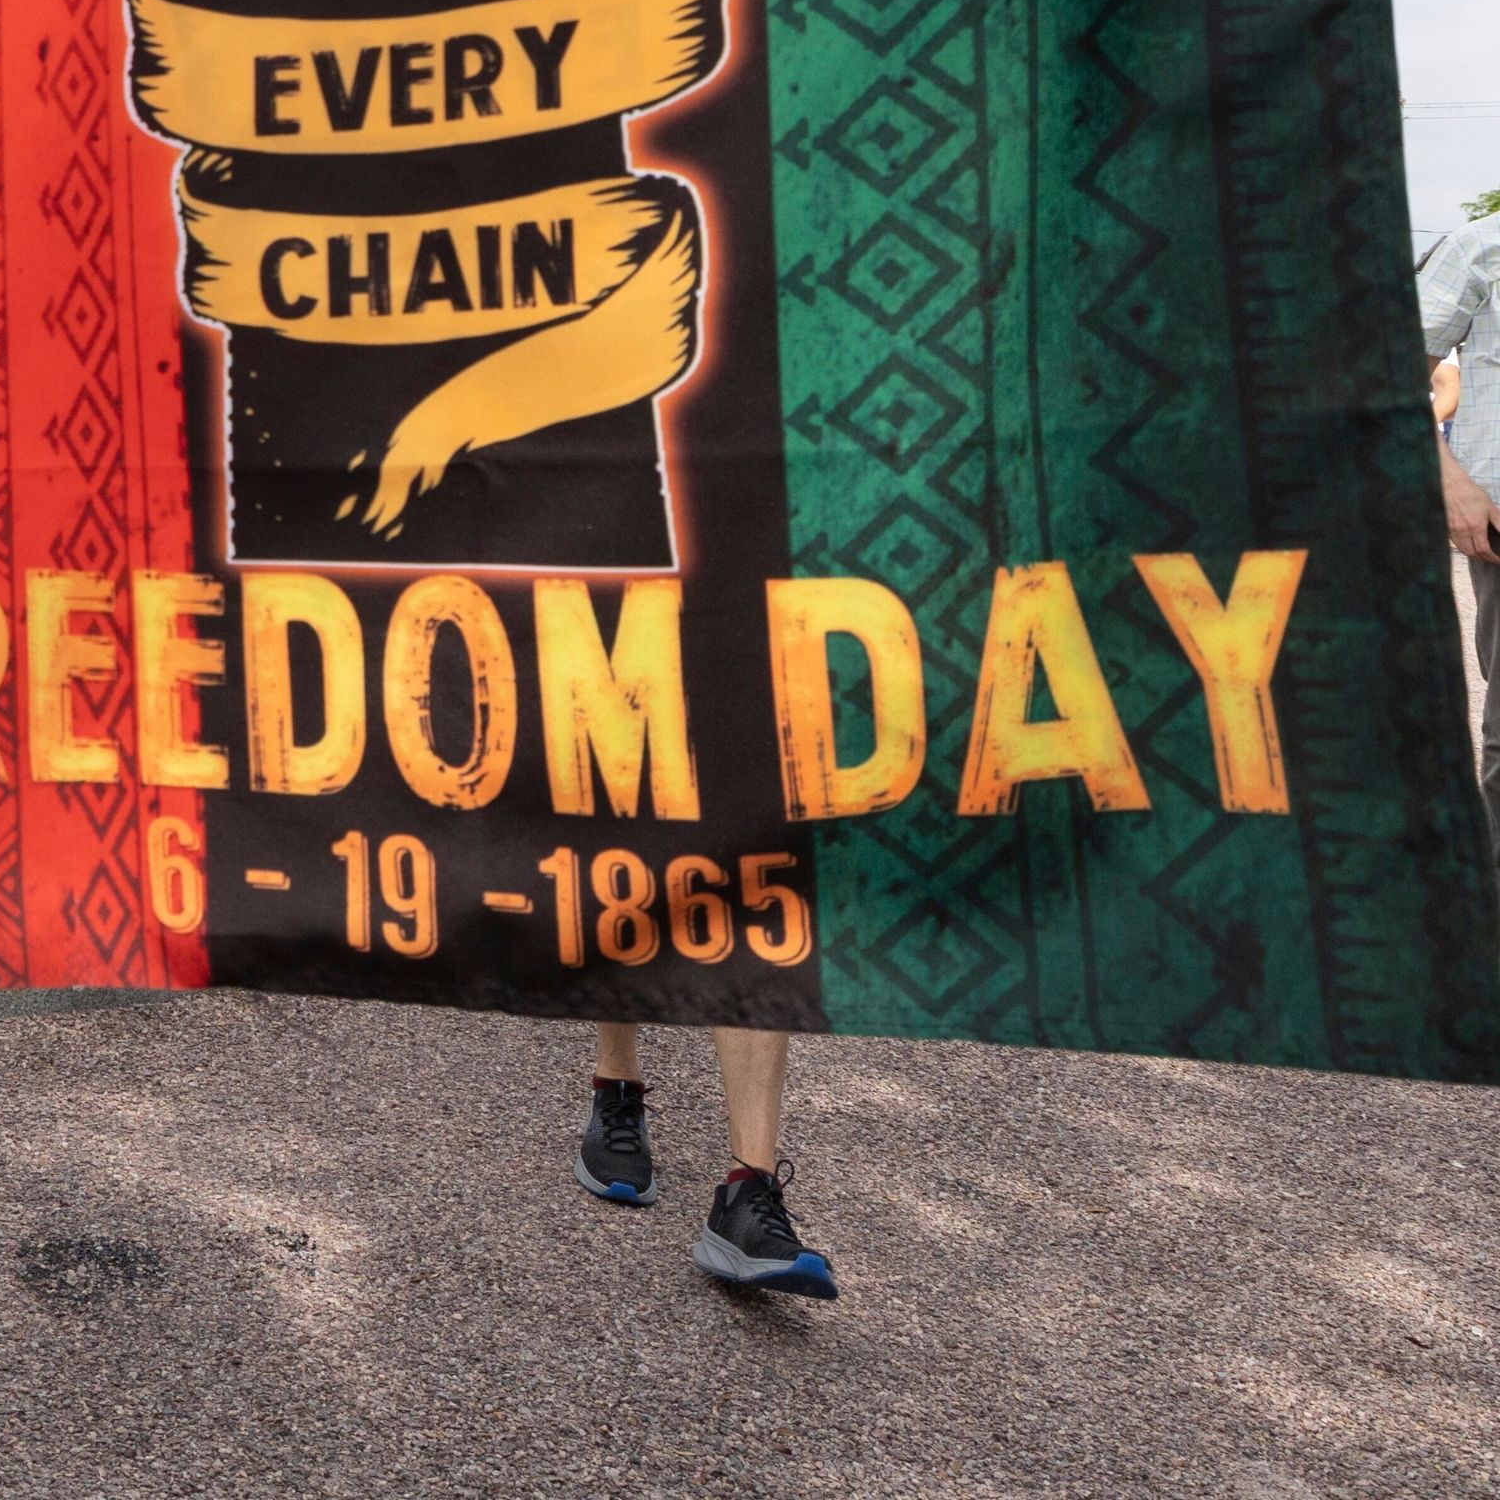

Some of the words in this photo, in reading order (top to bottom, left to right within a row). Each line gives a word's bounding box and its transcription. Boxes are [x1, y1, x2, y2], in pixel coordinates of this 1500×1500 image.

[253, 20, 580, 137] EVERY
[259, 218, 577, 321] CHAIN
[765, 549, 1307, 822] DAY
[150, 821, 205, 933] 6
[331, 830, 438, 962] 19
